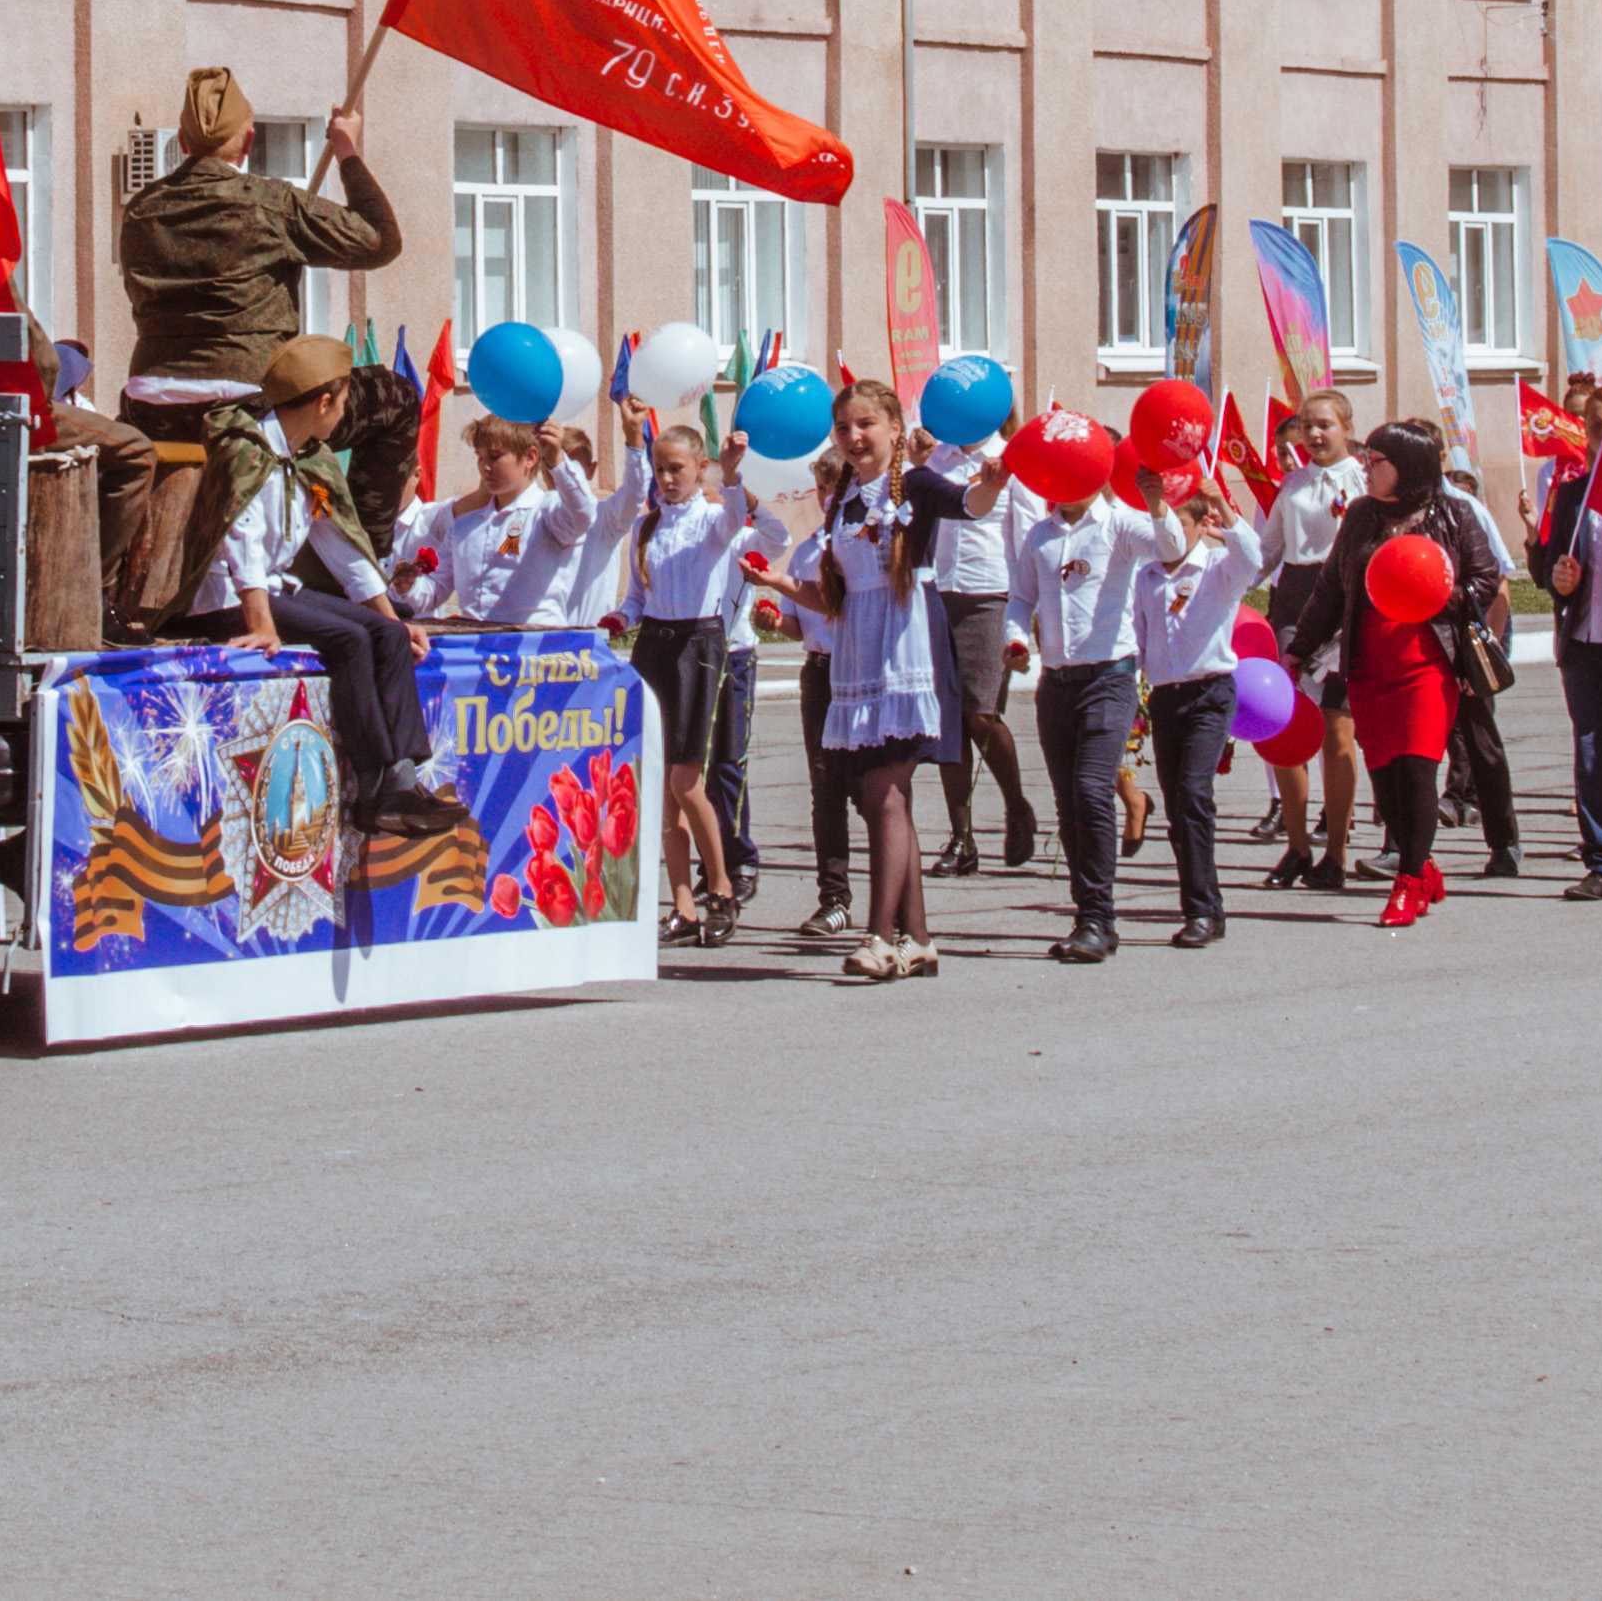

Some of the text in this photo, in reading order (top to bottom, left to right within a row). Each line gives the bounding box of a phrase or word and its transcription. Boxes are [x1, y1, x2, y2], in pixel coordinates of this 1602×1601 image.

[601, 39, 656, 88] 79
[486, 653, 512, 687] С
[454, 687, 627, 756] Победы!
[280, 729, 316, 750] СССР
[273, 853, 316, 874] ПОБЕДА
